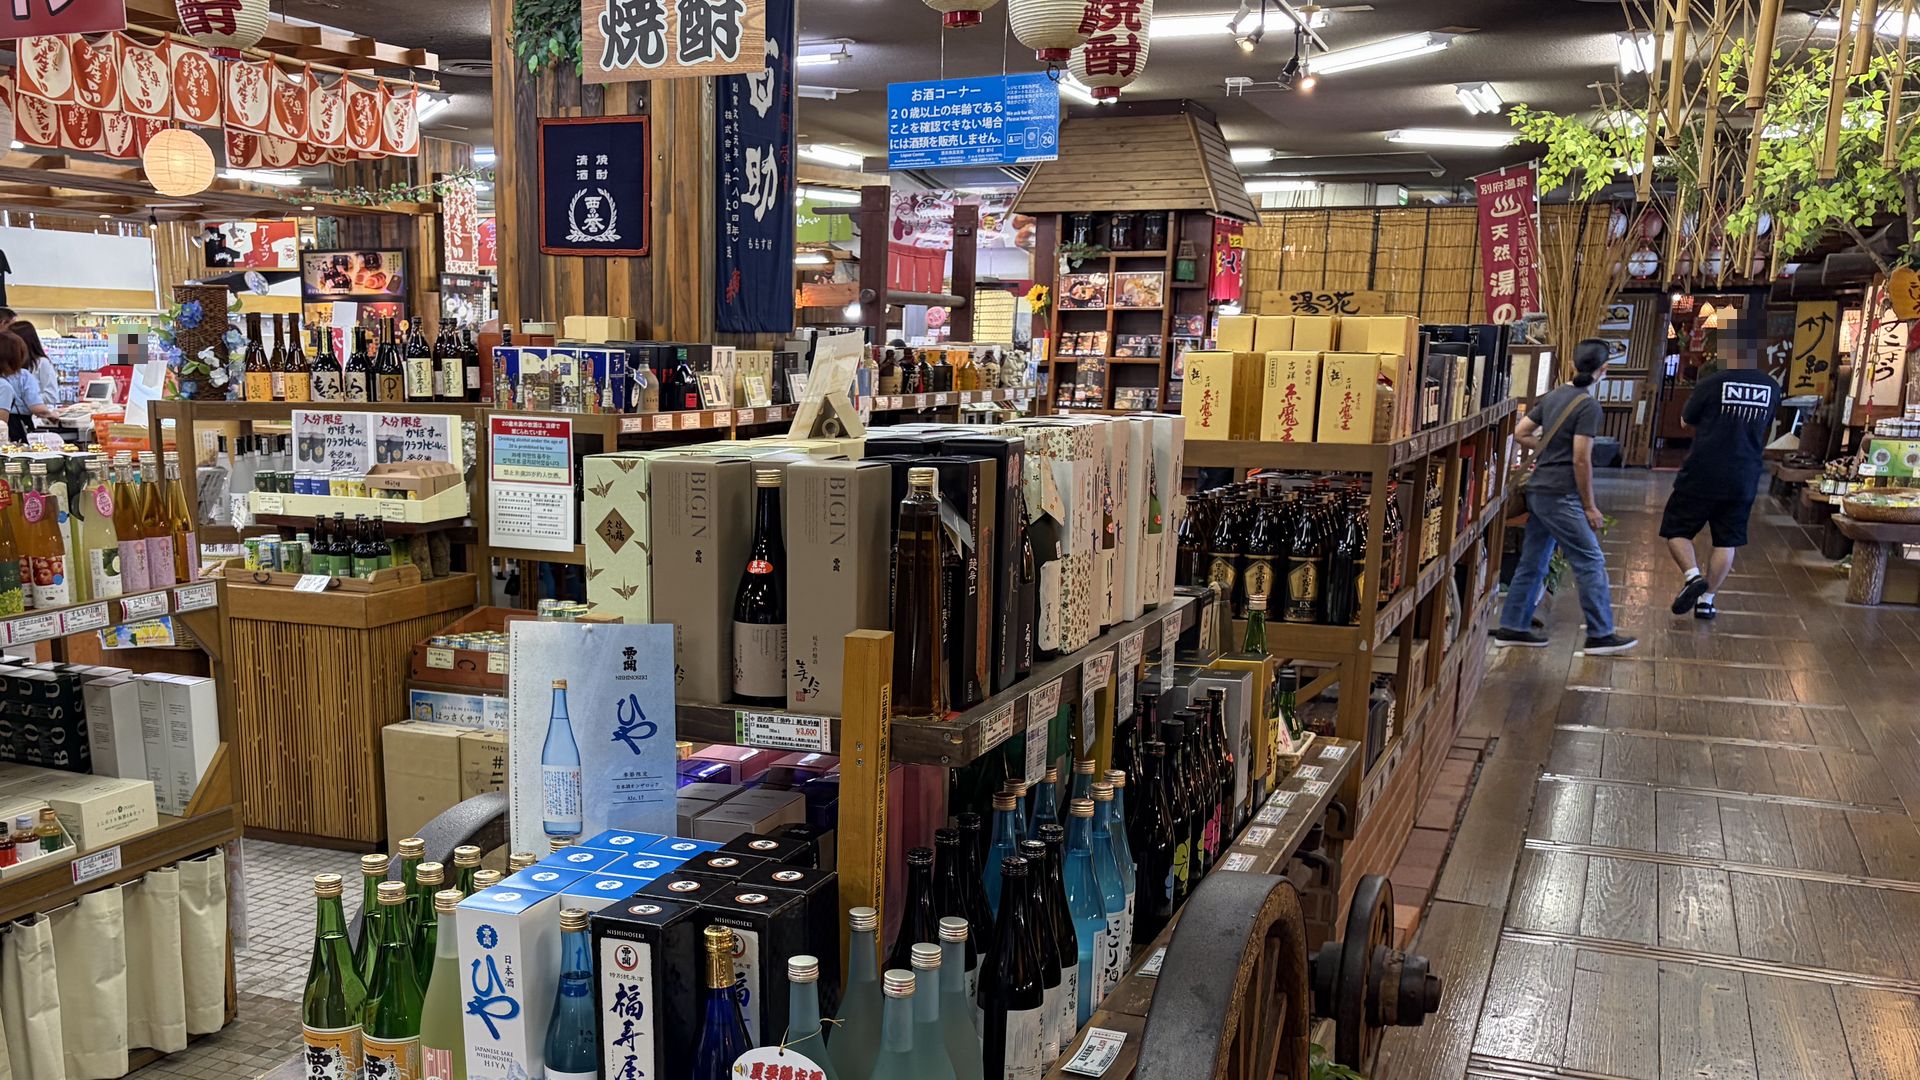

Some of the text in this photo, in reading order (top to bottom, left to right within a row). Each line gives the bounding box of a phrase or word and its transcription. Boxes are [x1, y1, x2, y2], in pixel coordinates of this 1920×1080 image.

[600, 0, 744, 69] 焼酎
[911, 85, 982, 102] お酒コーナー
[890, 116, 1003, 135] ことを確認できない場合
[889, 133, 1001, 150] には酒類を販売しません。
[1042, 135, 1052, 144] 20
[1480, 176, 1528, 195] 別府温泉
[1290, 291, 1360, 315] 湯の花
[1727, 387, 1768, 401] NIN
[302, 413, 344, 425] 大分限定
[380, 416, 423, 427] 大分限定
[690, 472, 708, 539] BIGIN
[830, 478, 846, 546] BIGIN
[606, 929, 645, 939] NISHINOSEKI
[504, 955, 515, 989] 日本酒
[475, 1045, 513, 1058] JAPANESE SAKE
[476, 1052, 513, 1063] NISHINOSEKI
[484, 1060, 506, 1070] HIYA
